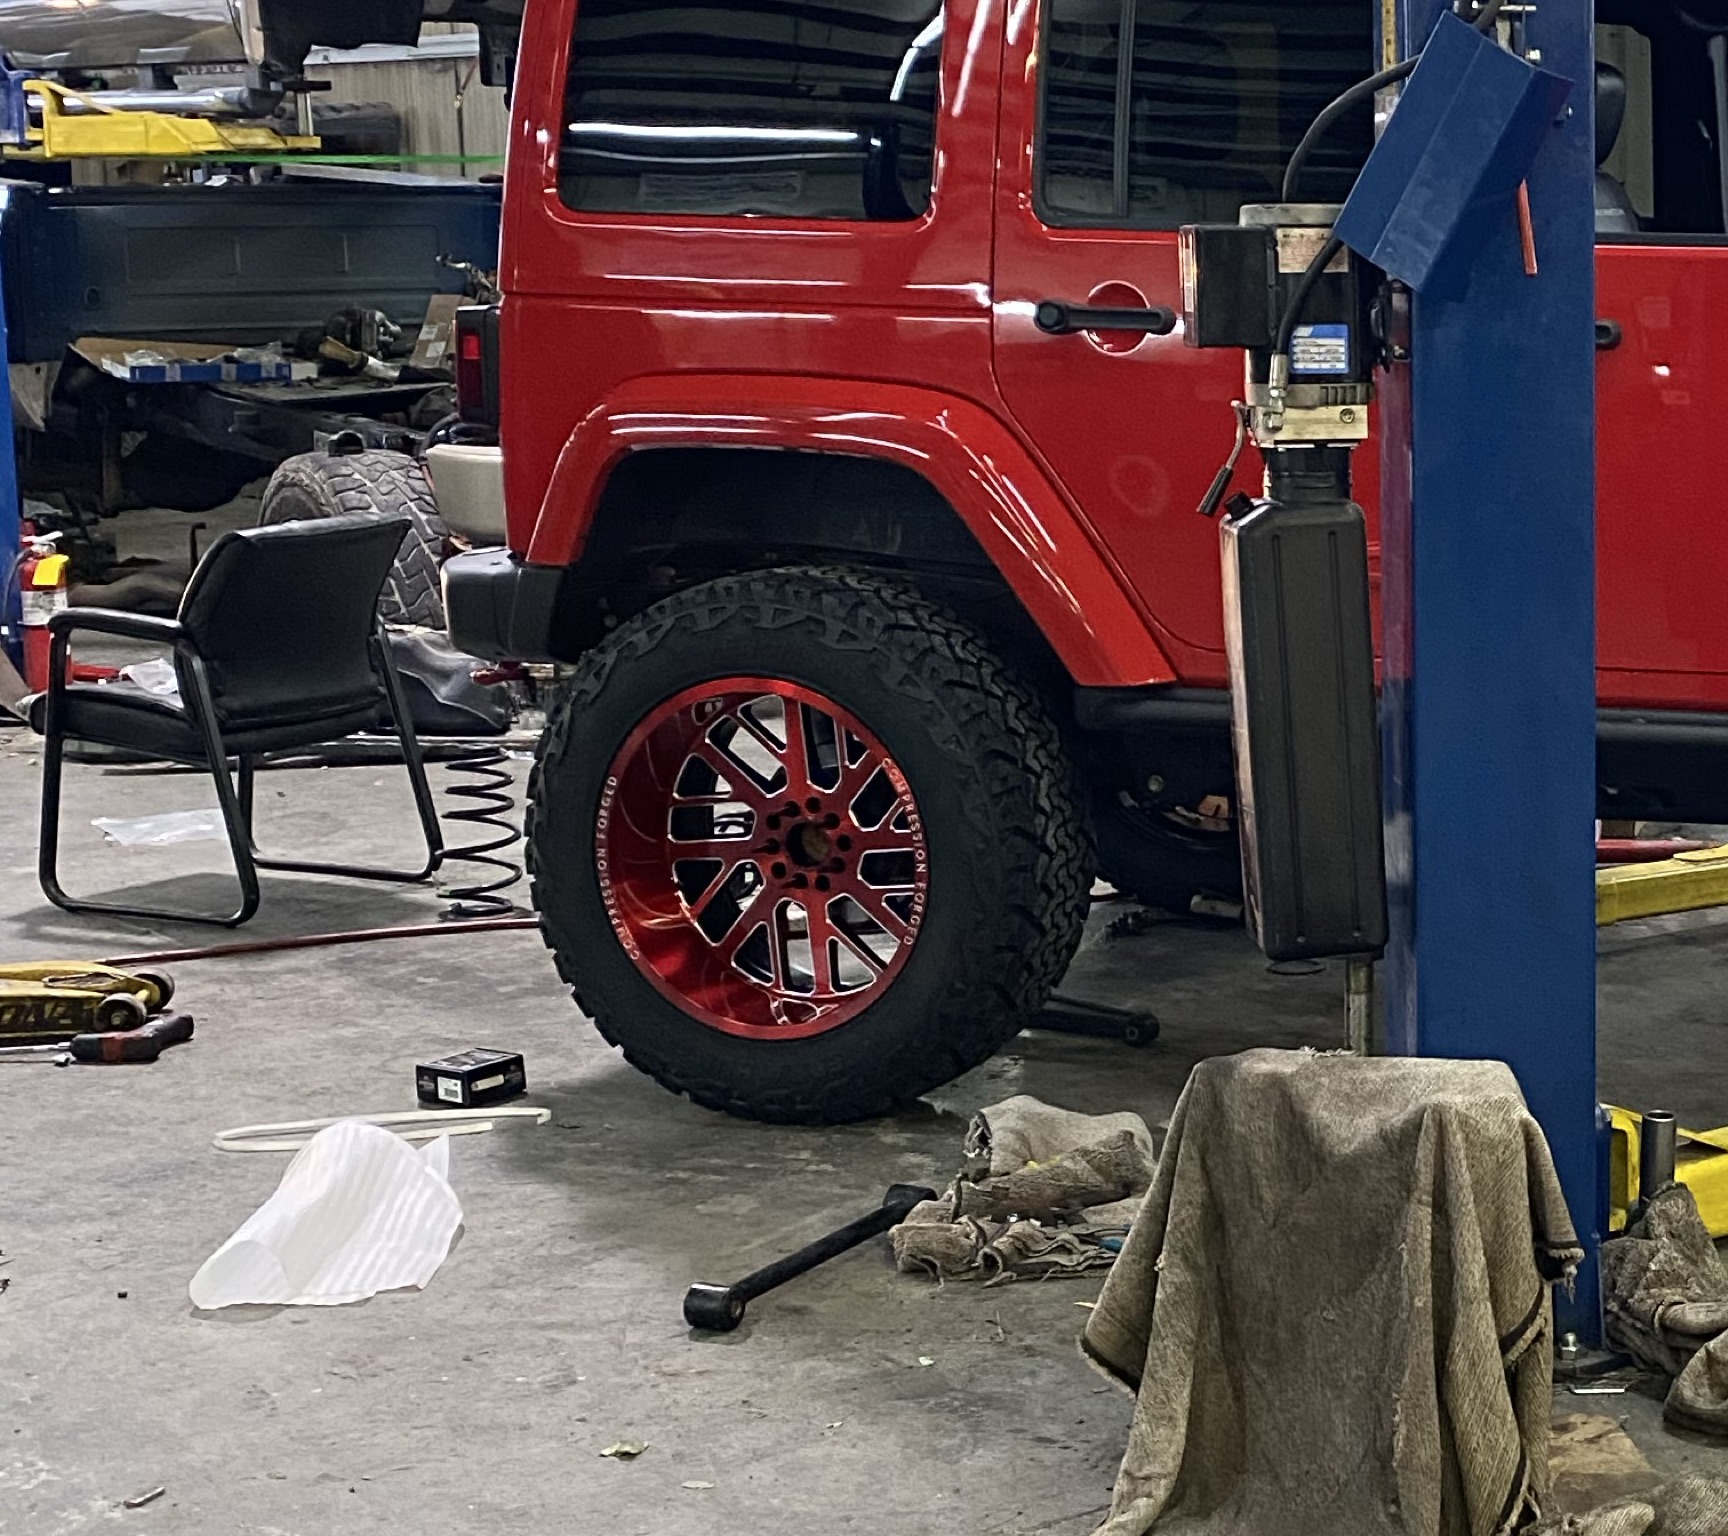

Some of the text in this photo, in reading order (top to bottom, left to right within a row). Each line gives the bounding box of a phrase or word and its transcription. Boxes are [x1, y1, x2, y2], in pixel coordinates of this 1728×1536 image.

[595, 775, 640, 960] COMPRESSION FORGED
[881, 757, 927, 946] COMPRESSION FORGED
